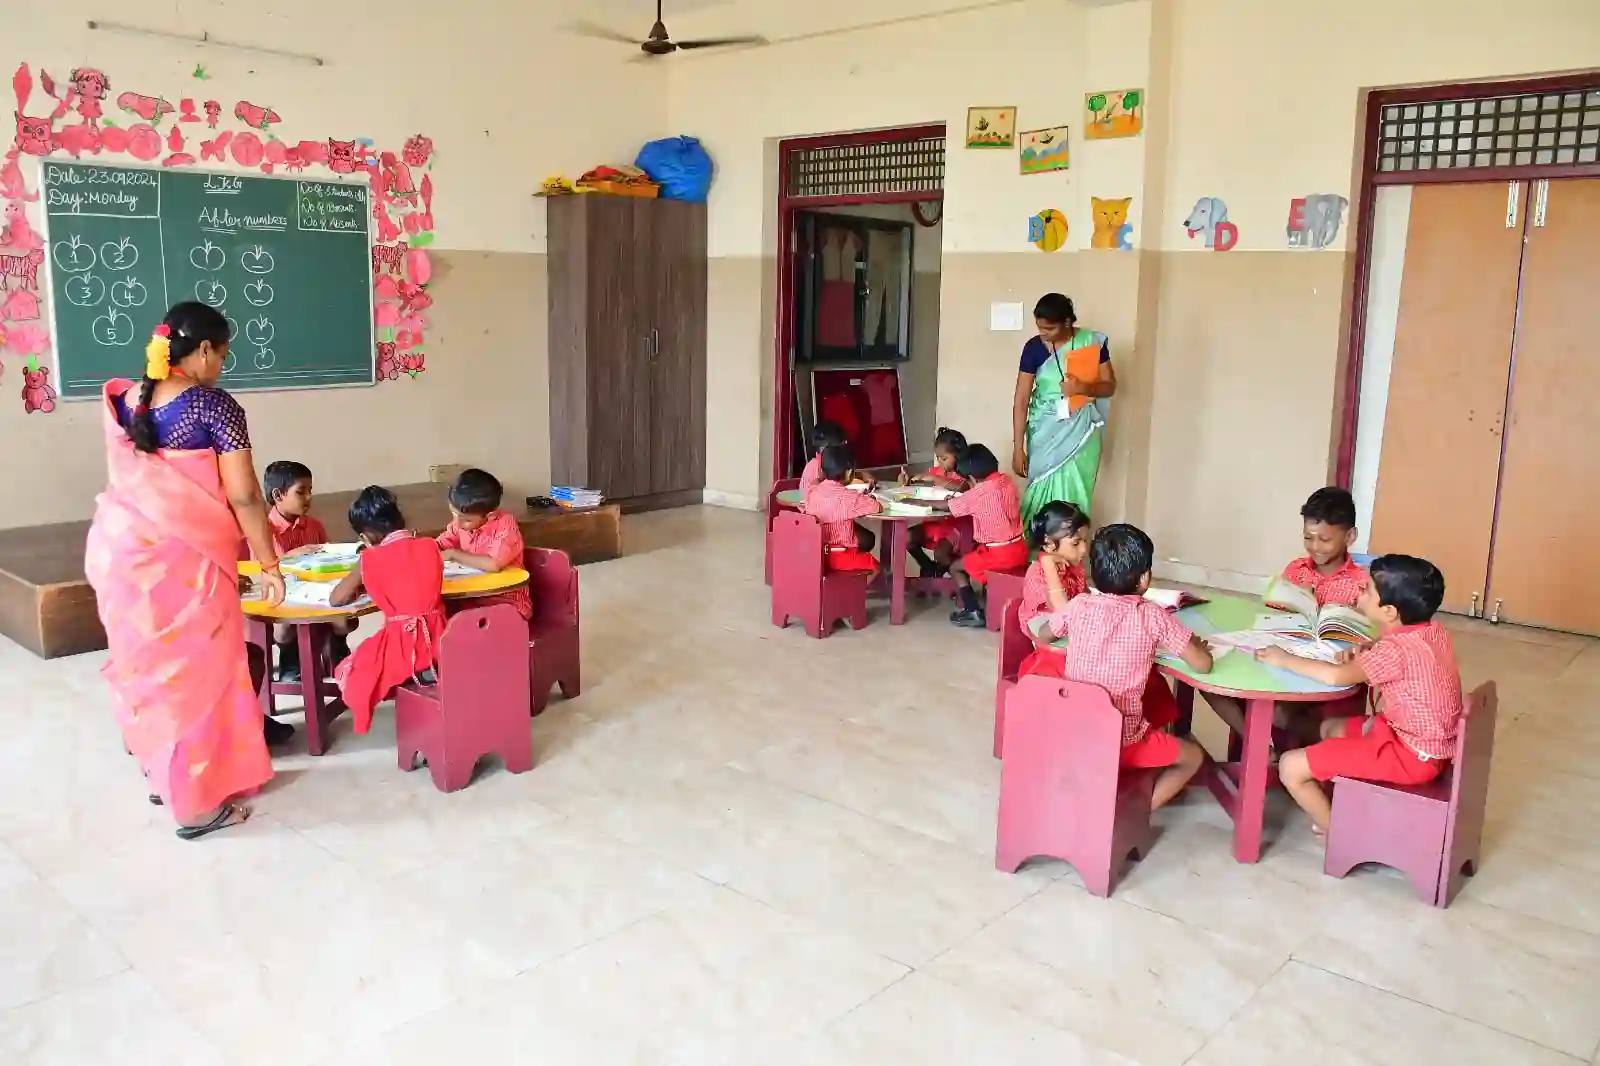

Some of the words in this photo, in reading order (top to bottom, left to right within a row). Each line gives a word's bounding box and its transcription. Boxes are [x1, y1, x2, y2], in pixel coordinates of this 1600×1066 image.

[1289, 199, 1306, 231] E
[1028, 216, 1043, 242] B
[1117, 222, 1132, 251] C
[1214, 222, 1239, 251] D
[69, 250, 79, 263] 1
[113, 251, 125, 263] 2
[80, 287, 92, 299] 3
[124, 289, 135, 303] 4
[107, 327, 117, 340] 5
